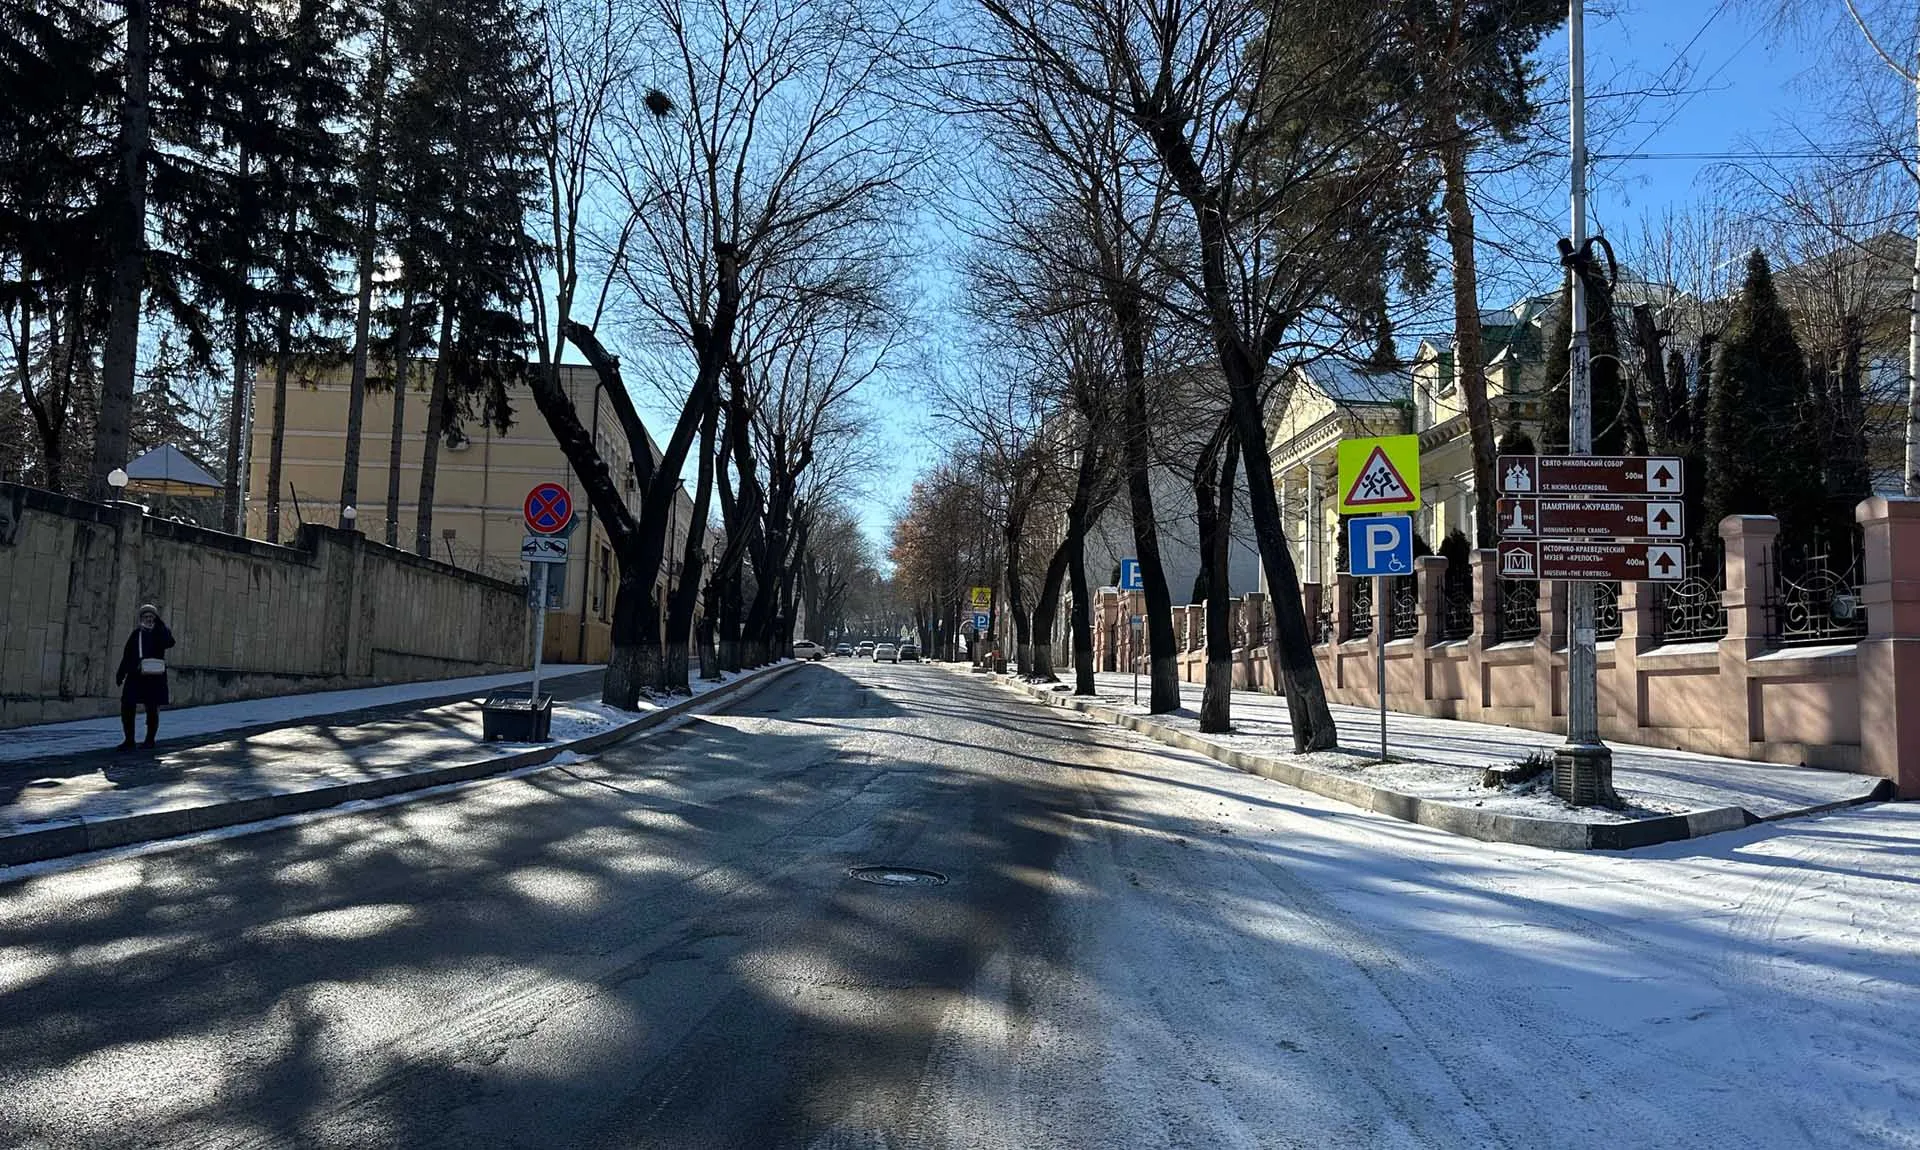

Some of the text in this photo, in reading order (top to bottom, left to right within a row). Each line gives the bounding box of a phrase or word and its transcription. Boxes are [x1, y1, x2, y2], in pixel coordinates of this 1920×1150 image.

[1542, 459, 1624, 468] СВЯТО-НИКОЛЬСКИЙ СОБОР
[1551, 483, 1577, 491] NICHOLAS
[1541, 502, 1624, 511] ПАМЯТНИК «ЖУРАВЛИ»
[1366, 524, 1400, 569] P
[1543, 544, 1625, 553] ИСТОРИКО-КРАЕВЕДЧЕСКИЙ
[1543, 553, 1604, 562] МУЗЕЙ «КРЕПОСТЬ»
